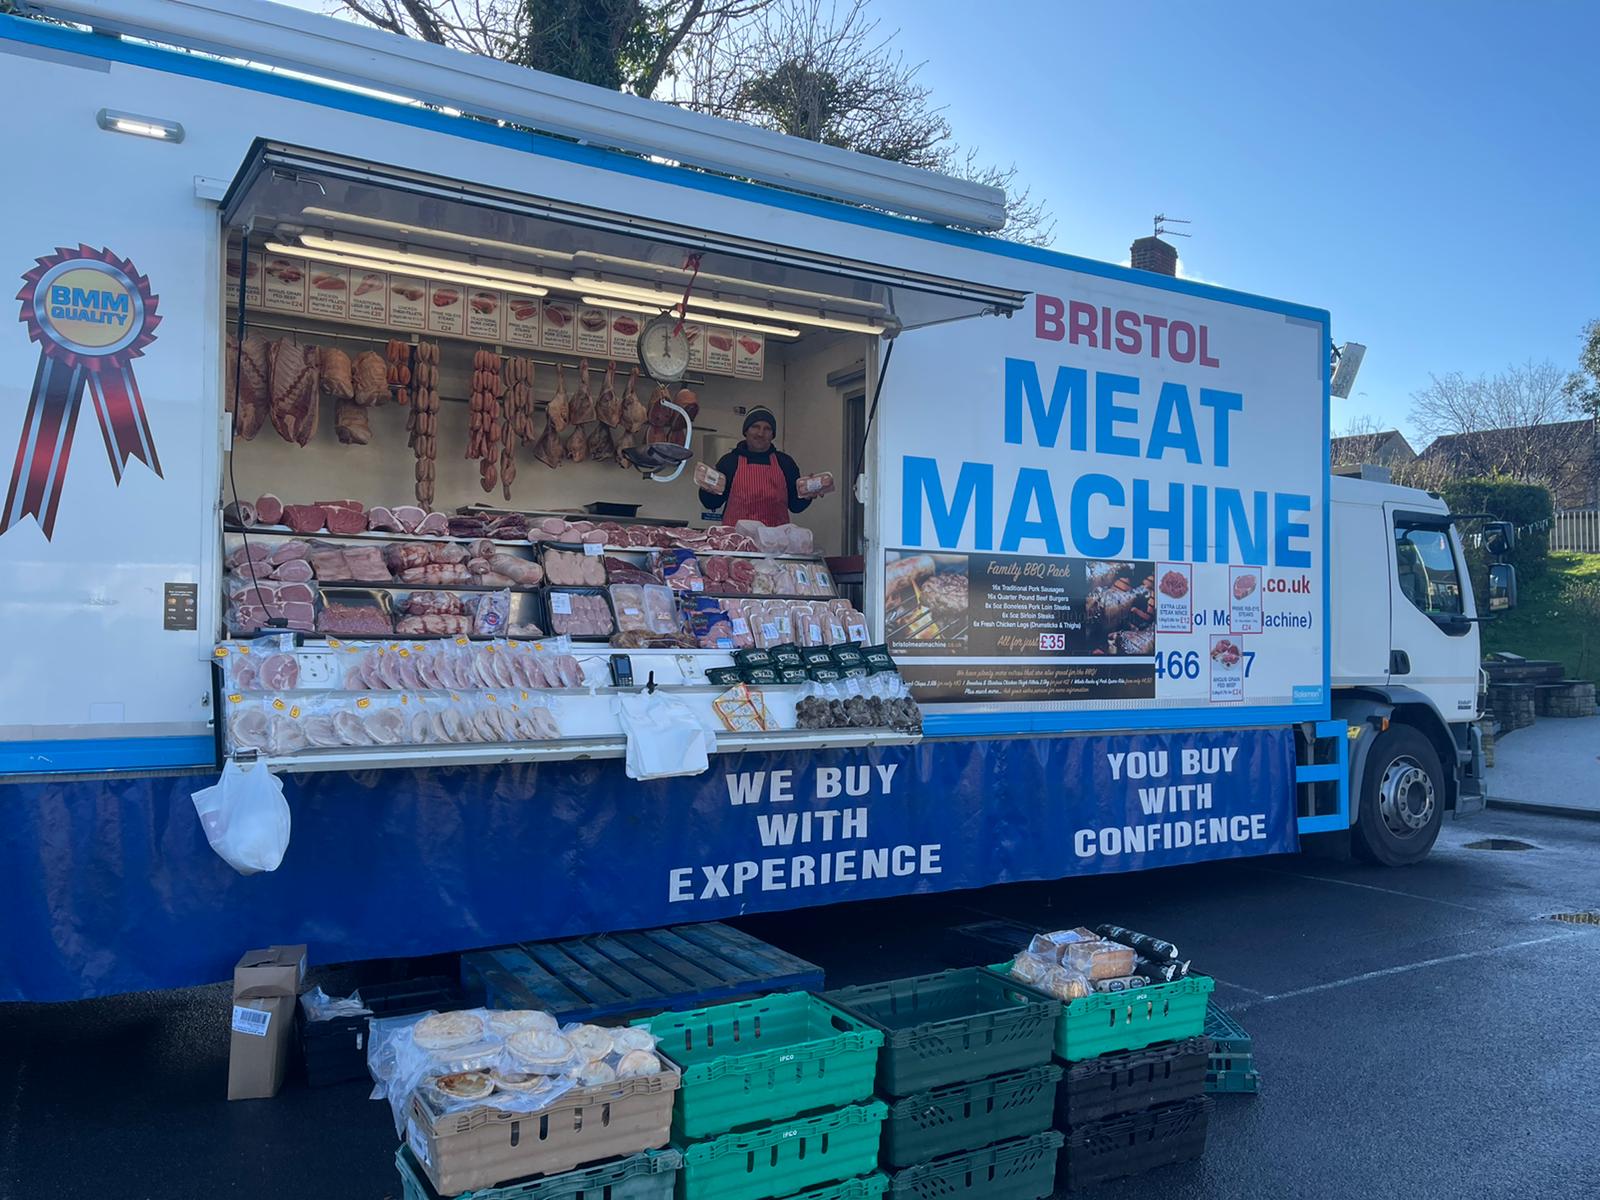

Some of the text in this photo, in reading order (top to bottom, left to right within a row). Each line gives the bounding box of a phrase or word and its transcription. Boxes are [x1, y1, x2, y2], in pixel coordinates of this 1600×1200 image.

[51, 285, 129, 313] BMM
[51, 306, 128, 326] QUALITY
[1035, 293, 1220, 368] BRISTOL
[1004, 357, 1243, 467] MEAT
[902, 455, 1311, 568] MACHINE
[987, 561, 1071, 582] Family BBQ Pack
[997, 593, 1017, 601] Quarter
[1049, 595, 1069, 603] Burgers
[1002, 584, 1027, 592] Traditional
[1040, 586, 1064, 594] Sausages
[1003, 602, 1028, 610] Boneless
[1261, 610, 1312, 629] achine)
[997, 635, 1009, 647] All
[1041, 635, 1064, 649] £35
[1106, 746, 1239, 780] YOU BUY
[726, 763, 898, 806] WE BUY
[1138, 783, 1213, 816] WITH
[757, 807, 868, 847] WITH
[1074, 814, 1267, 858] CONFIDENCE
[669, 843, 942, 903] EXPERIENCE
